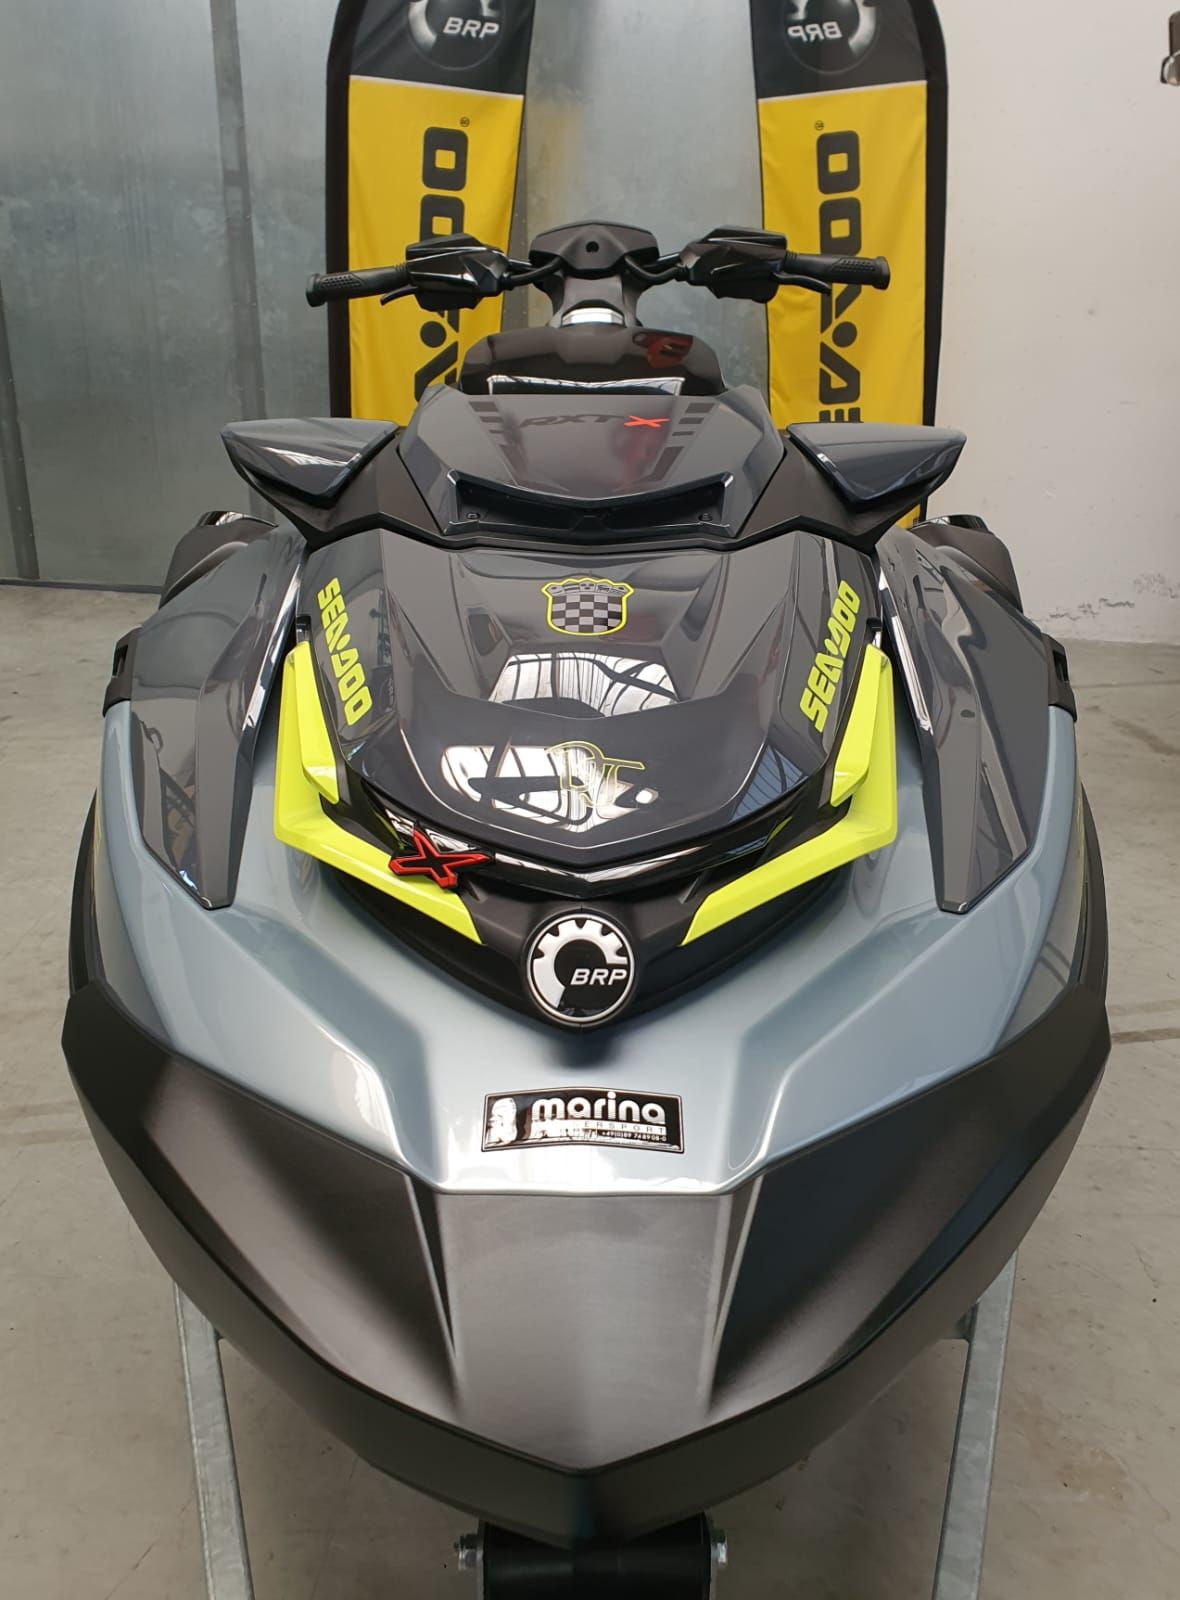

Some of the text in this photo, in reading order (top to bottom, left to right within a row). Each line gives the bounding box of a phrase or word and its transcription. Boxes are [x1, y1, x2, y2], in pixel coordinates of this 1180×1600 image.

[443, 16, 500, 38] BRP
[623, 415, 671, 428] X
[570, 968, 628, 986] BRP
[531, 1091, 666, 1125] marina
